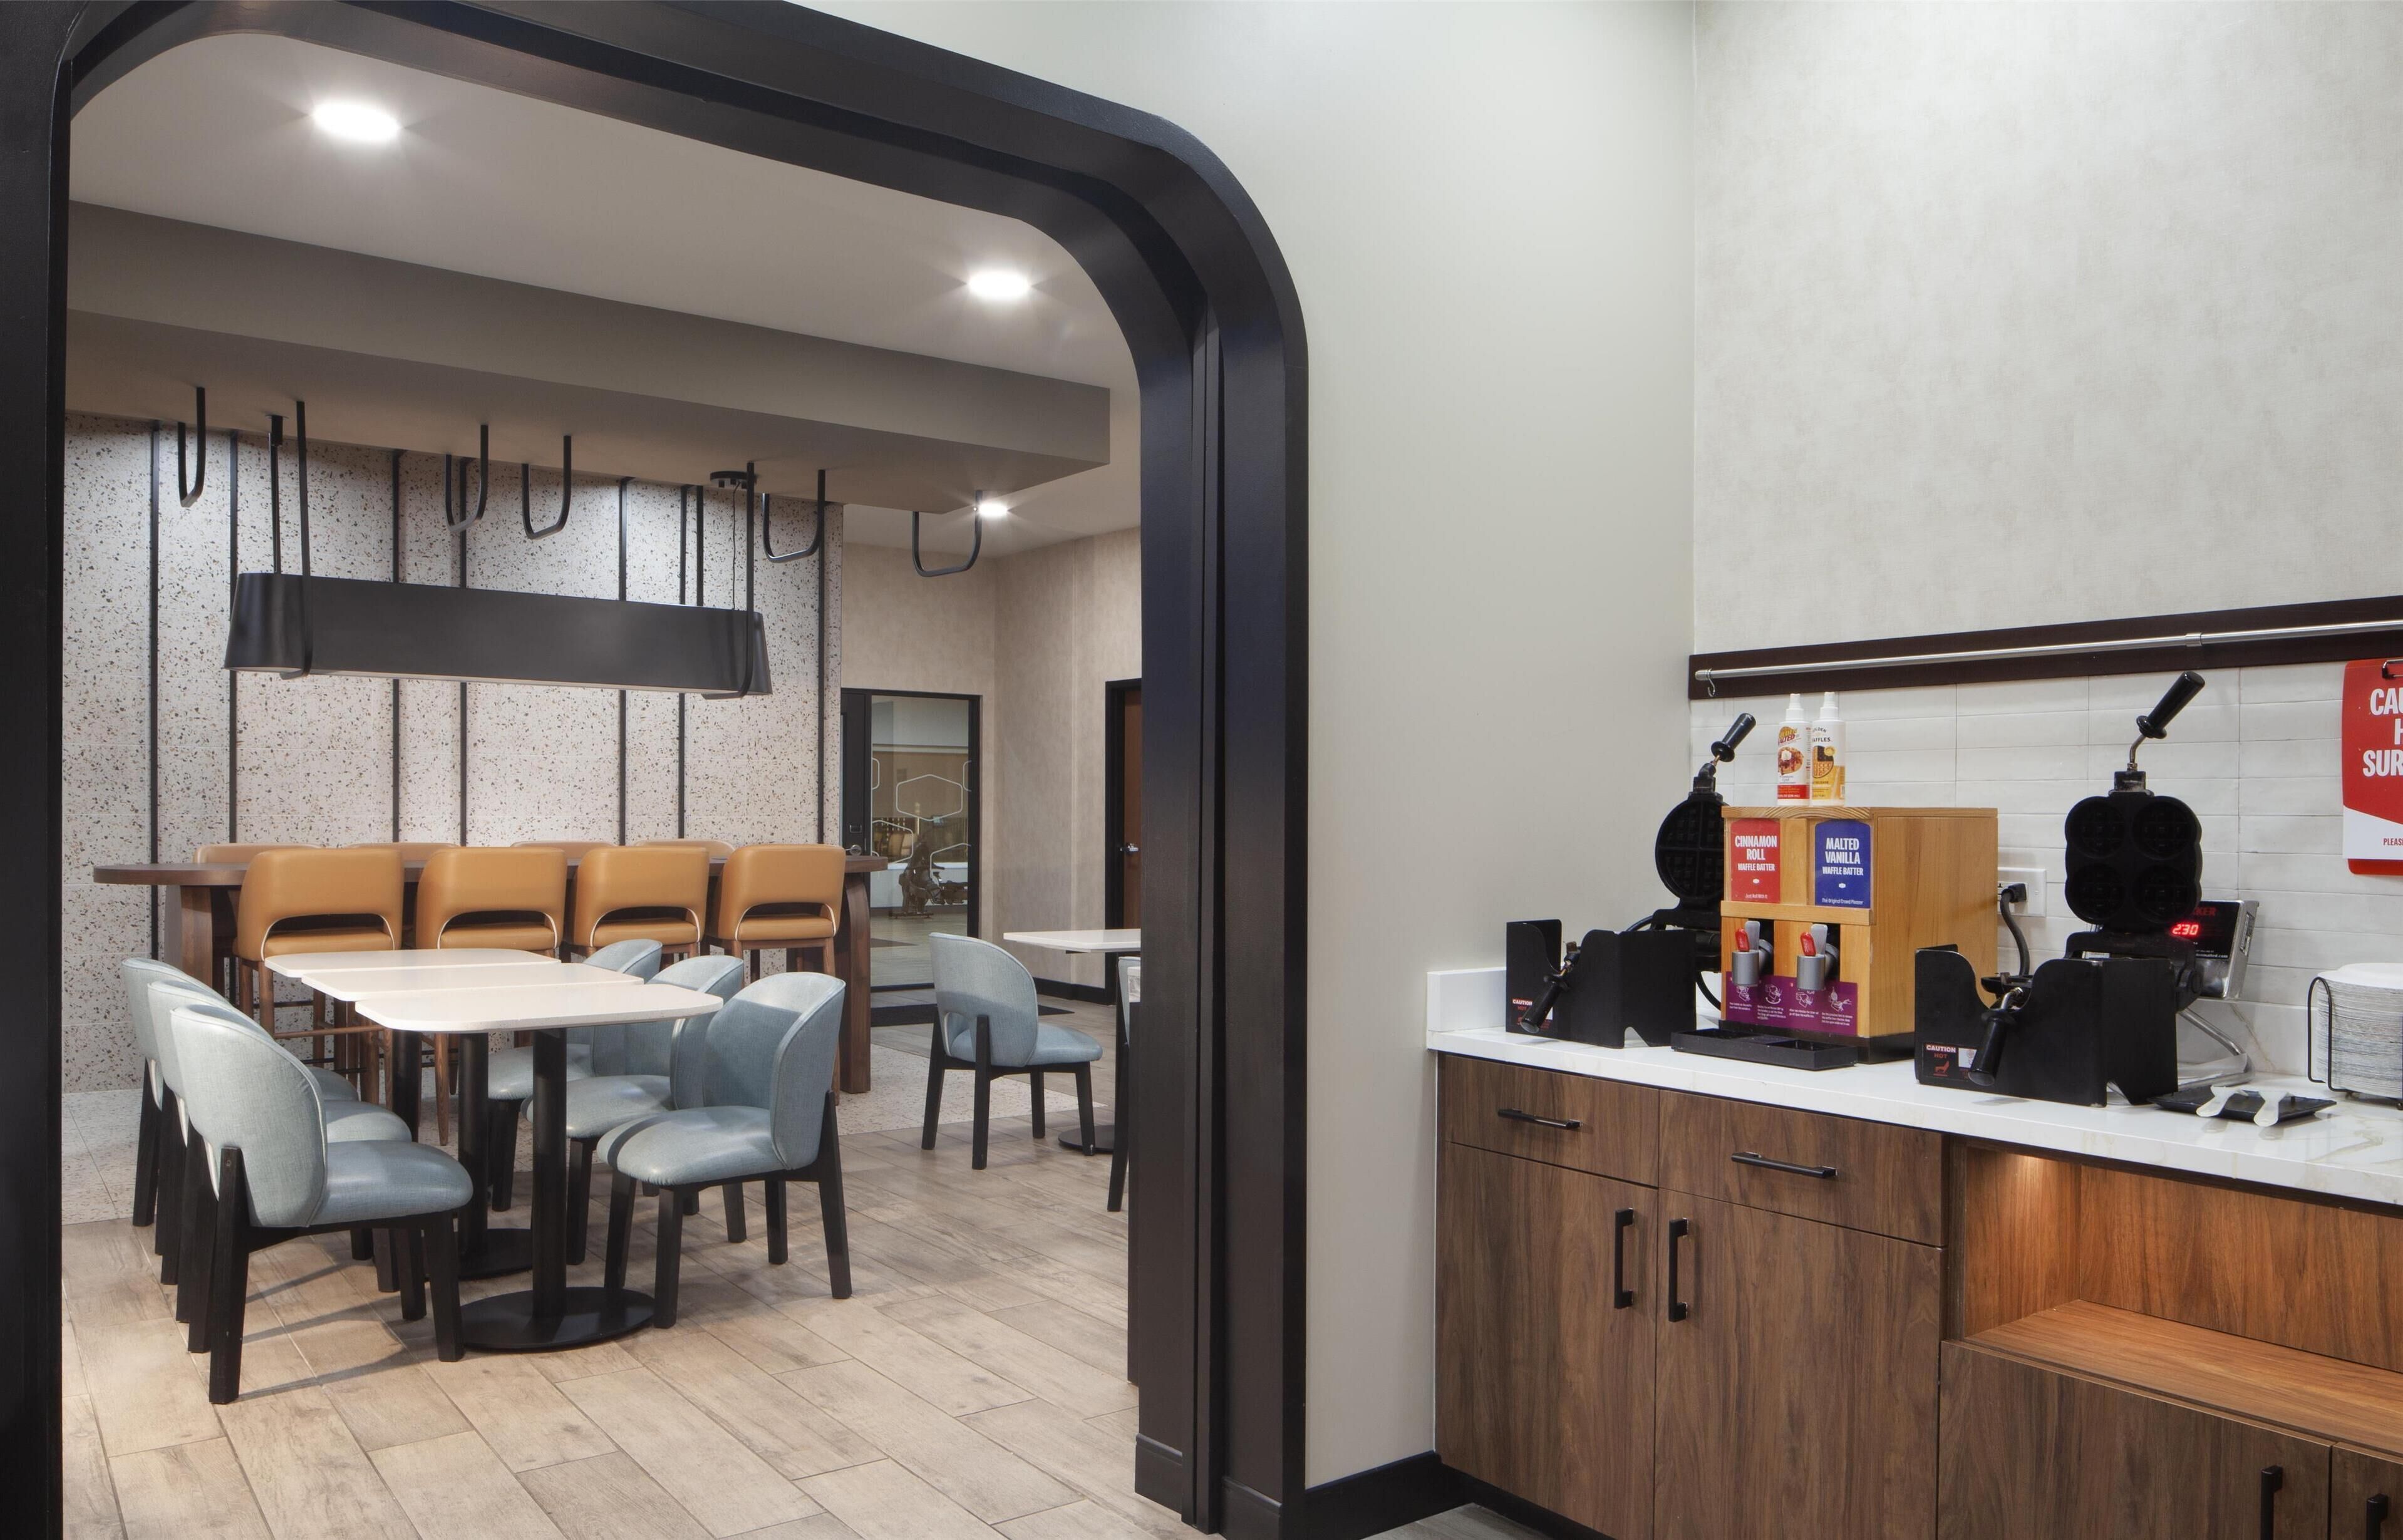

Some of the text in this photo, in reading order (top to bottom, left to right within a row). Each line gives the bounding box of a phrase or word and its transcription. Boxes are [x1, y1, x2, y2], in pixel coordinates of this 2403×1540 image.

[1735, 835, 1777, 847] CINNAMON
[1826, 837, 1860, 850] MALTED
[2383, 837, 2403, 846] PLEAS
[1746, 849, 1766, 860] ROLL
[1825, 851, 1861, 864] VANILLA
[1737, 863, 1756, 871] WAFFLE
[1822, 866, 1864, 876] WAFFLE BATTER
[2194, 907, 2217, 916] KER
[1926, 1045, 1956, 1053] CAUTION
